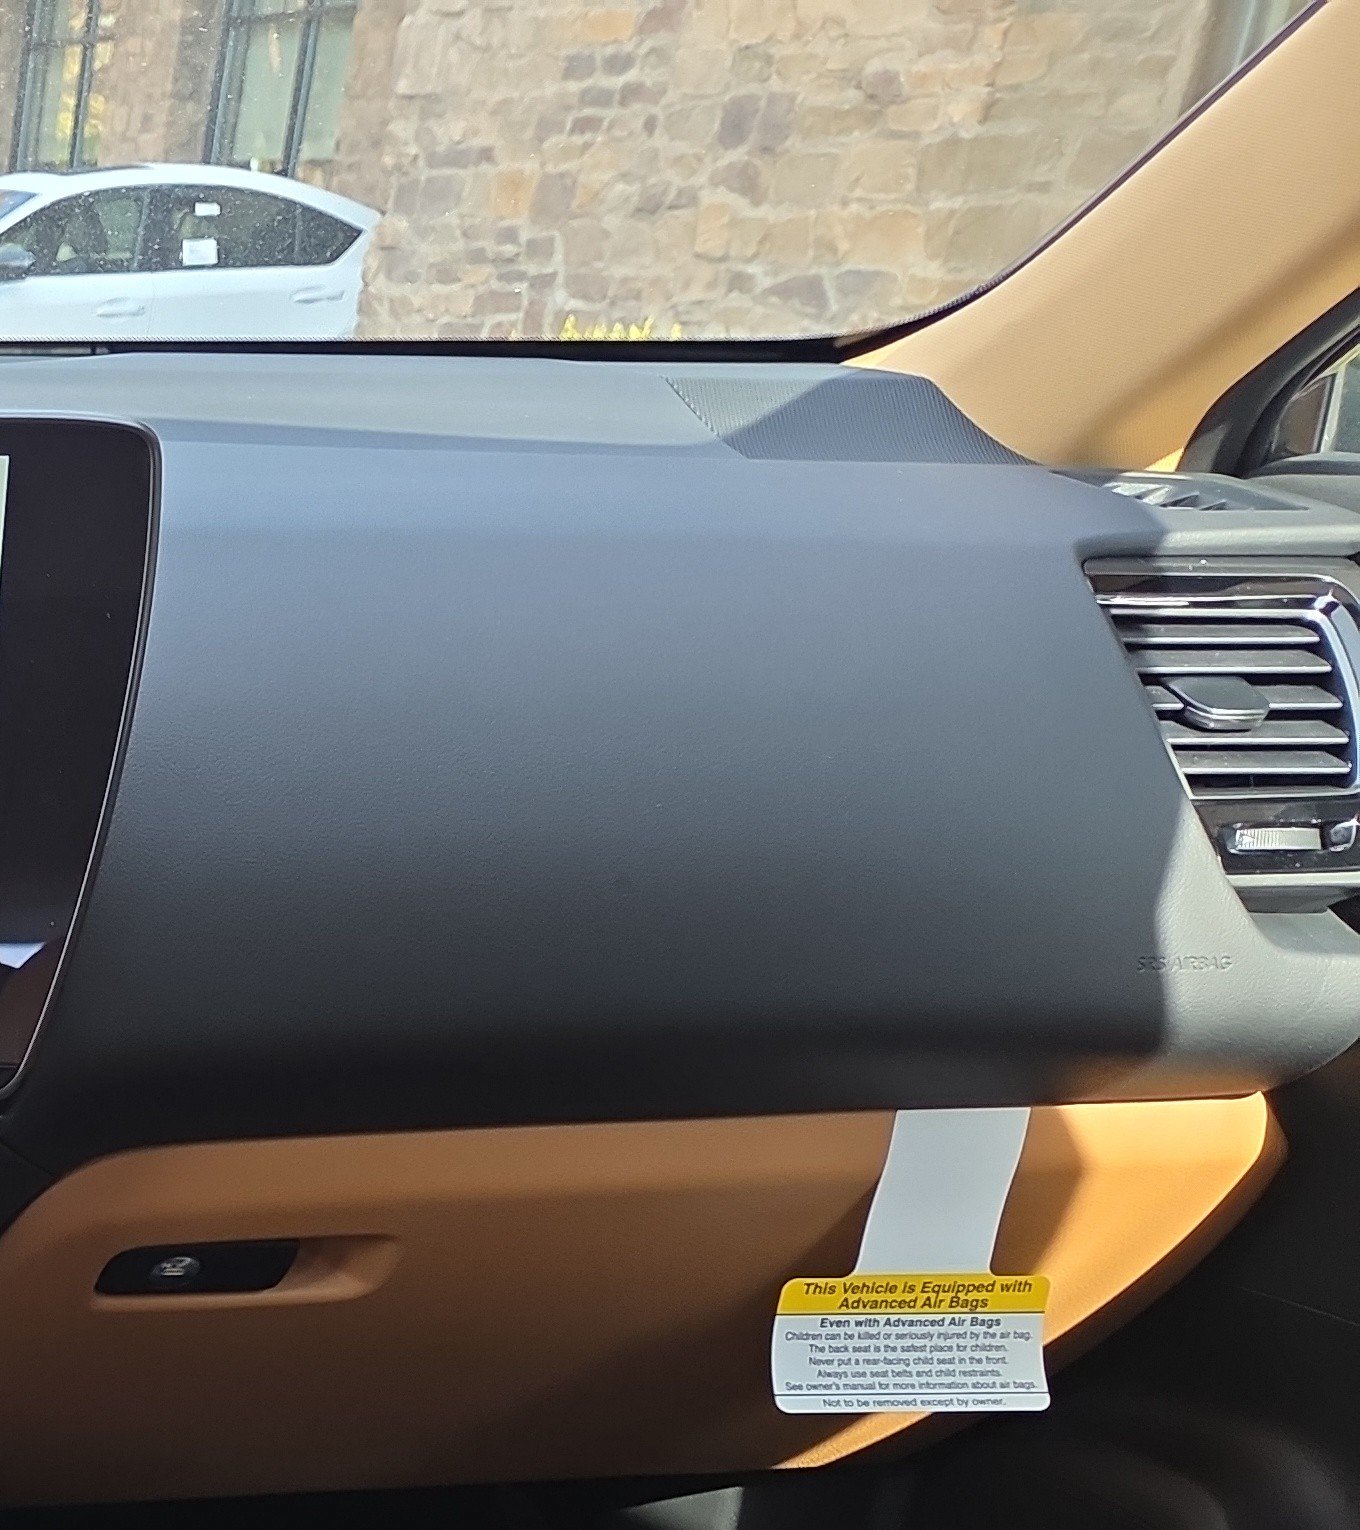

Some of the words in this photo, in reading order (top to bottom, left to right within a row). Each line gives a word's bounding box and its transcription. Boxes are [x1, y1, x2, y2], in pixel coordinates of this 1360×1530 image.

[804, 1281, 837, 1295] This
[842, 1281, 898, 1295] Vehicle
[921, 1279, 996, 1298] Equipped
[1000, 1279, 1032, 1293] with
[837, 1296, 919, 1310] Advanced
[921, 1296, 945, 1309] Air
[948, 1296, 989, 1311] Bags
[820, 1317, 850, 1328] Even
[854, 1317, 880, 1328] with
[883, 1317, 945, 1328] Advanced
[948, 1317, 966, 1327] Air
[969, 1317, 1001, 1329] Bags
[785, 1331, 822, 1341] Children
[825, 1332, 841, 1341] can
[844, 1331, 855, 1341] be
[882, 1332, 892, 1341] or
[895, 1331, 935, 1342] seriously
[969, 1331, 980, 1342] by
[982, 1331, 997, 1340] the
[998, 1331, 1011, 1340] air
[809, 1343, 826, 1353] The
[828, 1343, 849, 1353] back
[852, 1344, 871, 1353] seat
[873, 1344, 882, 1353] is
[884, 1343, 897, 1353] the
[900, 1343, 927, 1353] safest
[929, 1343, 953, 1354] place
[956, 1343, 967, 1352] for
[808, 1357, 834, 1366] Never
[837, 1357, 852, 1367] put
[854, 1358, 860, 1366] a
[862, 1356, 911, 1367] rear-facing
[912, 1356, 934, 1365] child
[936, 1357, 955, 1365] seat
[958, 1356, 966, 1365] in
[969, 1356, 983, 1365] the
[817, 1369, 848, 1380] Always
[851, 1370, 867, 1378] use
[869, 1370, 889, 1378] seat
[891, 1369, 913, 1378] belts
[915, 1369, 933, 1378] and
[935, 1369, 956, 1378] child
[785, 1381, 803, 1391] See
[805, 1382, 841, 1391] owner's
[843, 1381, 876, 1390] manual
[878, 1381, 890, 1390] for
[892, 1382, 916, 1390] more
[918, 1381, 968, 1390] information
[971, 1381, 997, 1390] about
[823, 1398, 841, 1408] Not
[843, 1398, 854, 1407] to
[856, 1398, 870, 1407] be
[873, 1398, 917, 1407] removed
[921, 1398, 953, 1408] except
[956, 1398, 969, 1408] by
